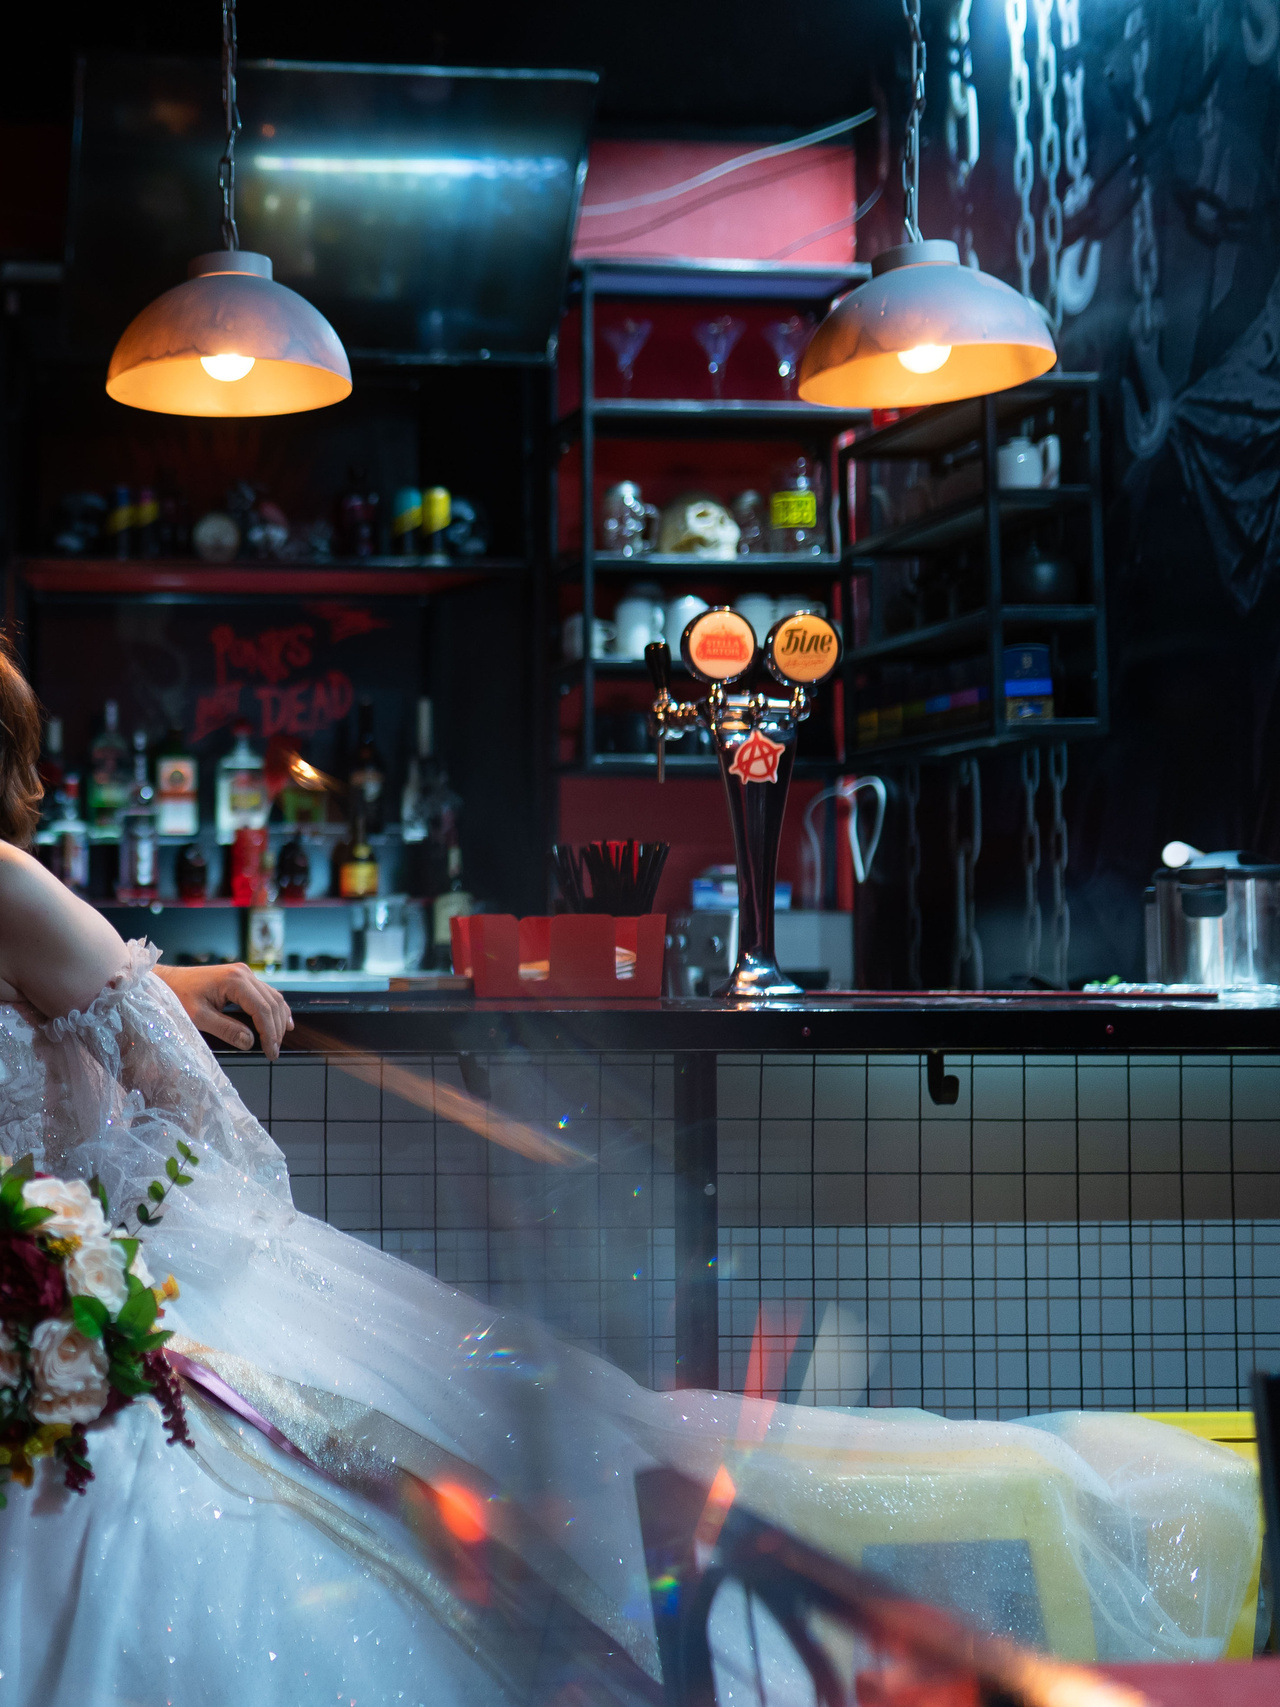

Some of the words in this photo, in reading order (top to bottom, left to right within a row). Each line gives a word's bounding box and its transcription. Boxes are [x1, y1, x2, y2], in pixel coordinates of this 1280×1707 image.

[706, 640, 739, 648] STELLA
[781, 627, 833, 656] Біле
[255, 669, 353, 738] DEAD
